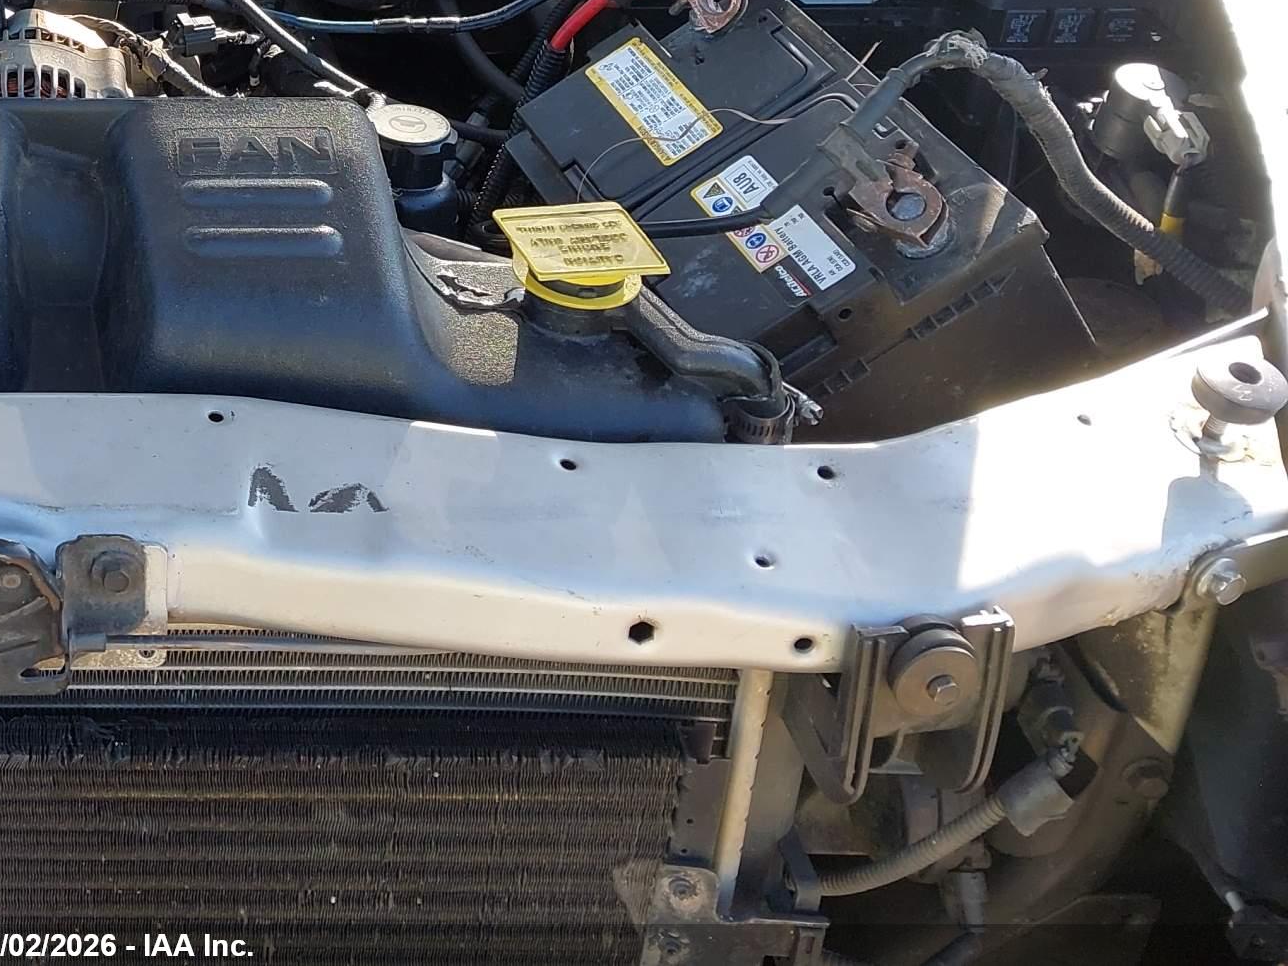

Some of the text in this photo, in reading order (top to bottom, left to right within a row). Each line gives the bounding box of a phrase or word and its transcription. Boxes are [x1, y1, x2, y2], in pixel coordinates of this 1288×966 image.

[178, 136, 334, 172] FAN
[733, 172, 760, 195] AU8
[774, 227, 827, 285] VRLA AGM Battery
[775, 265, 808, 297] ACDelco
